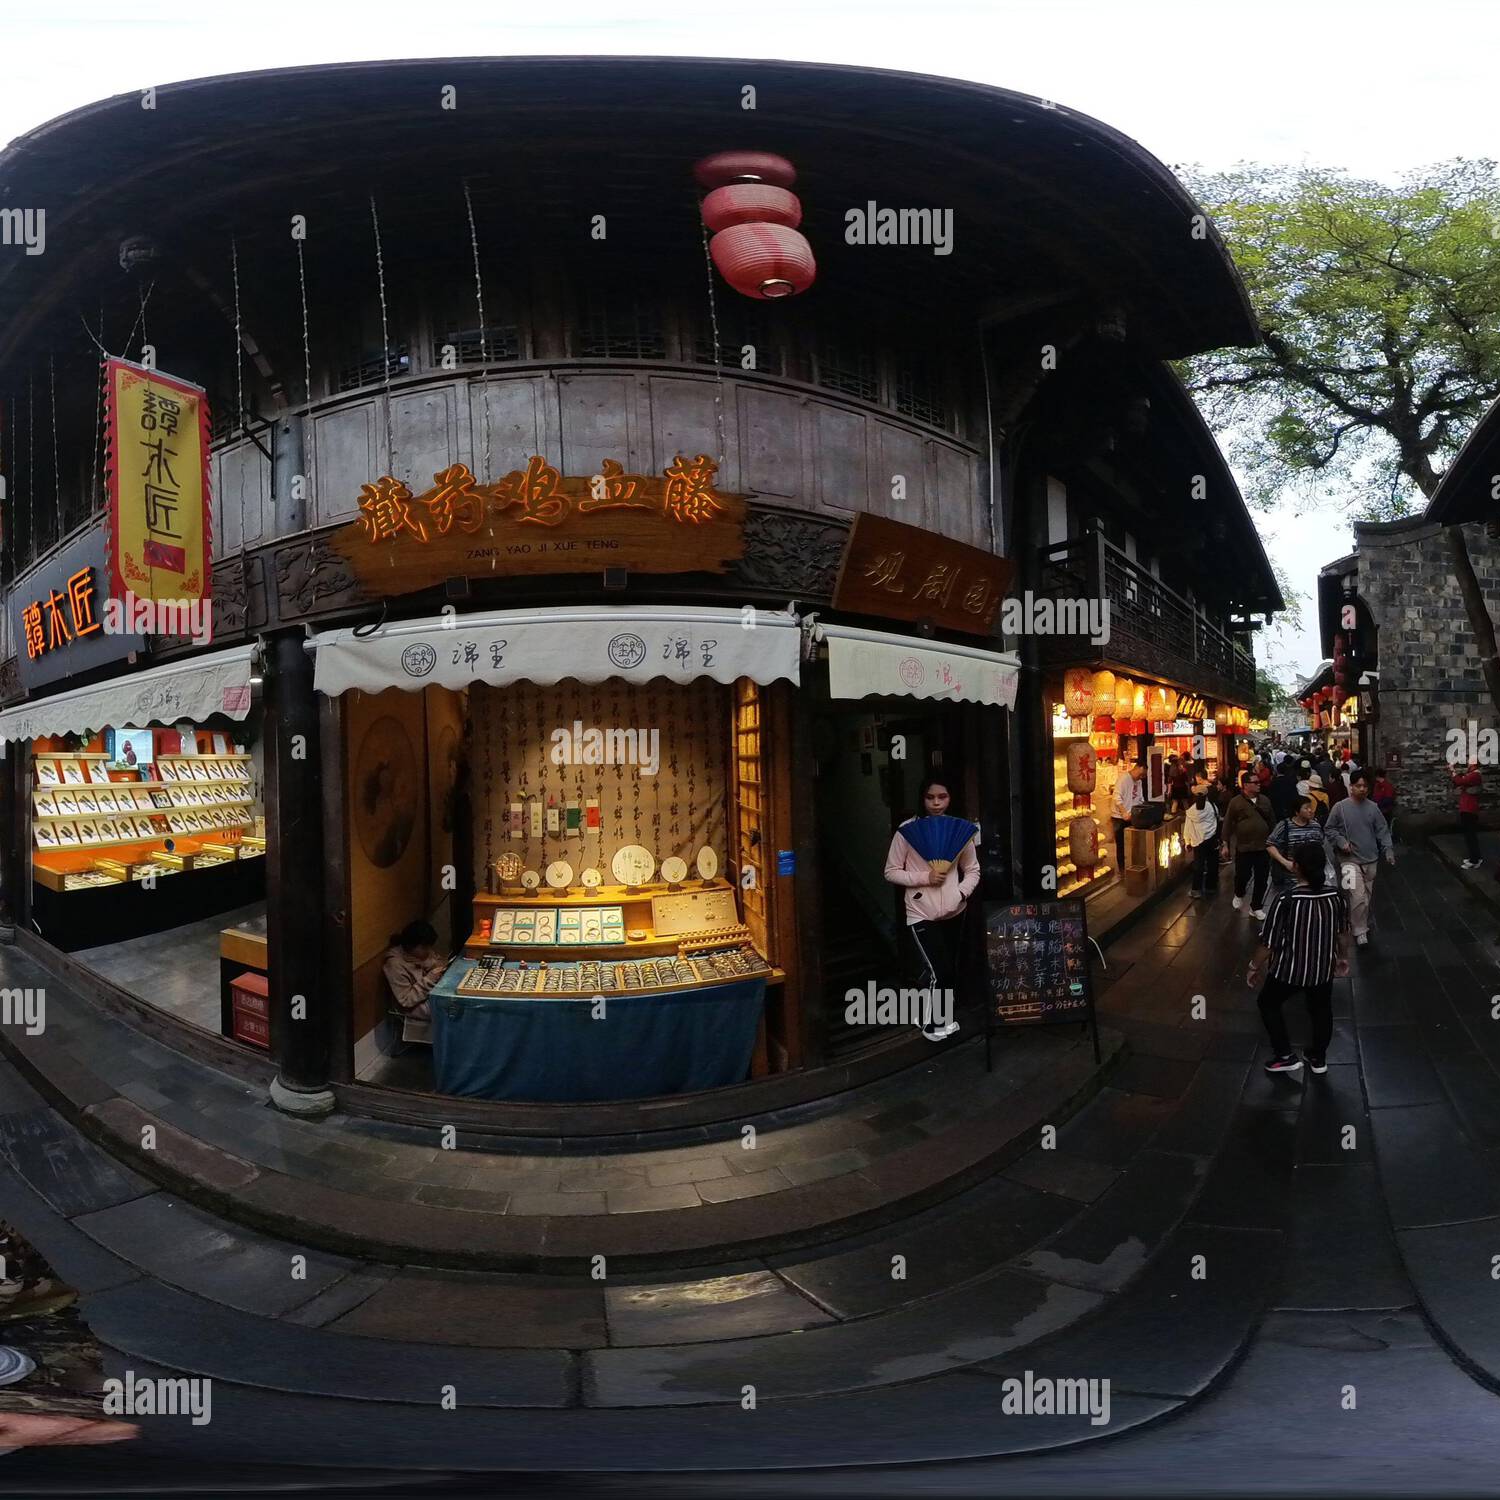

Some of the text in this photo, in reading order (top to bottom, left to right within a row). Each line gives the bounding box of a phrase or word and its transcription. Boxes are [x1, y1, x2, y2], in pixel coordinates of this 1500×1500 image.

[466, 540, 619, 559] ZANG YAO JI XUE TENG
